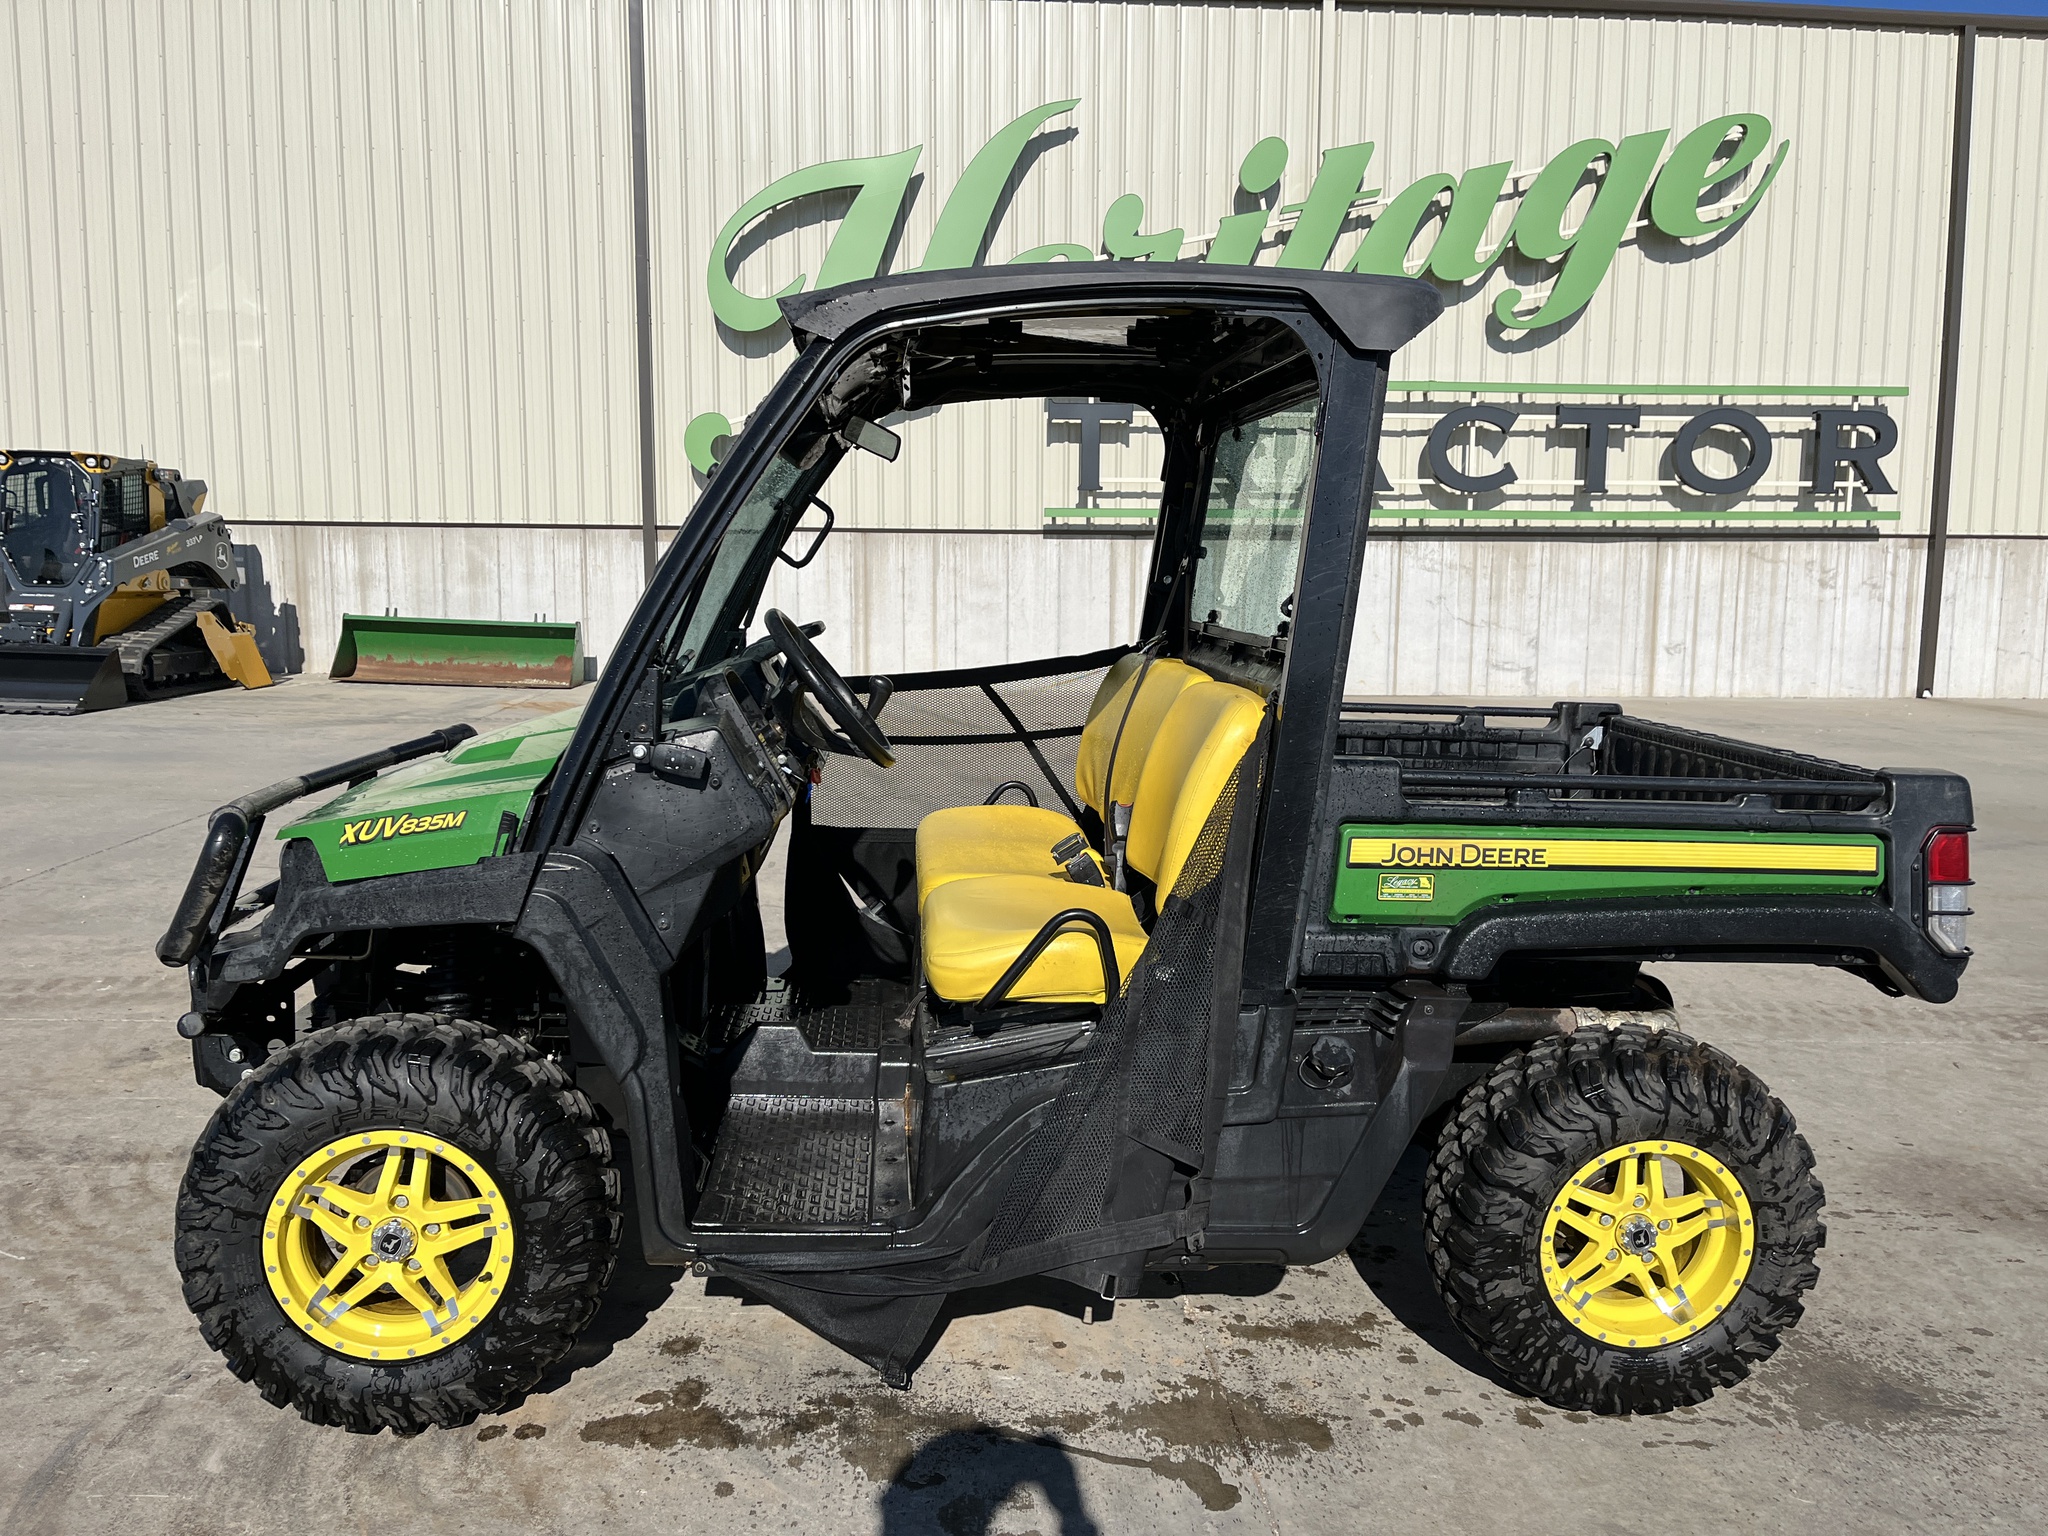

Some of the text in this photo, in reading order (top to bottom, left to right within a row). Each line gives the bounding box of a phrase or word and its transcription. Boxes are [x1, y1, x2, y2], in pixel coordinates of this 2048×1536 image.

[685, 98, 1790, 474] Hritage
[1048, 403, 1898, 495] TCTOR
[132, 549, 160, 568] DEERE
[338, 810, 468, 847] XUV835M
[1381, 842, 1547, 866] JOHN DEERE
